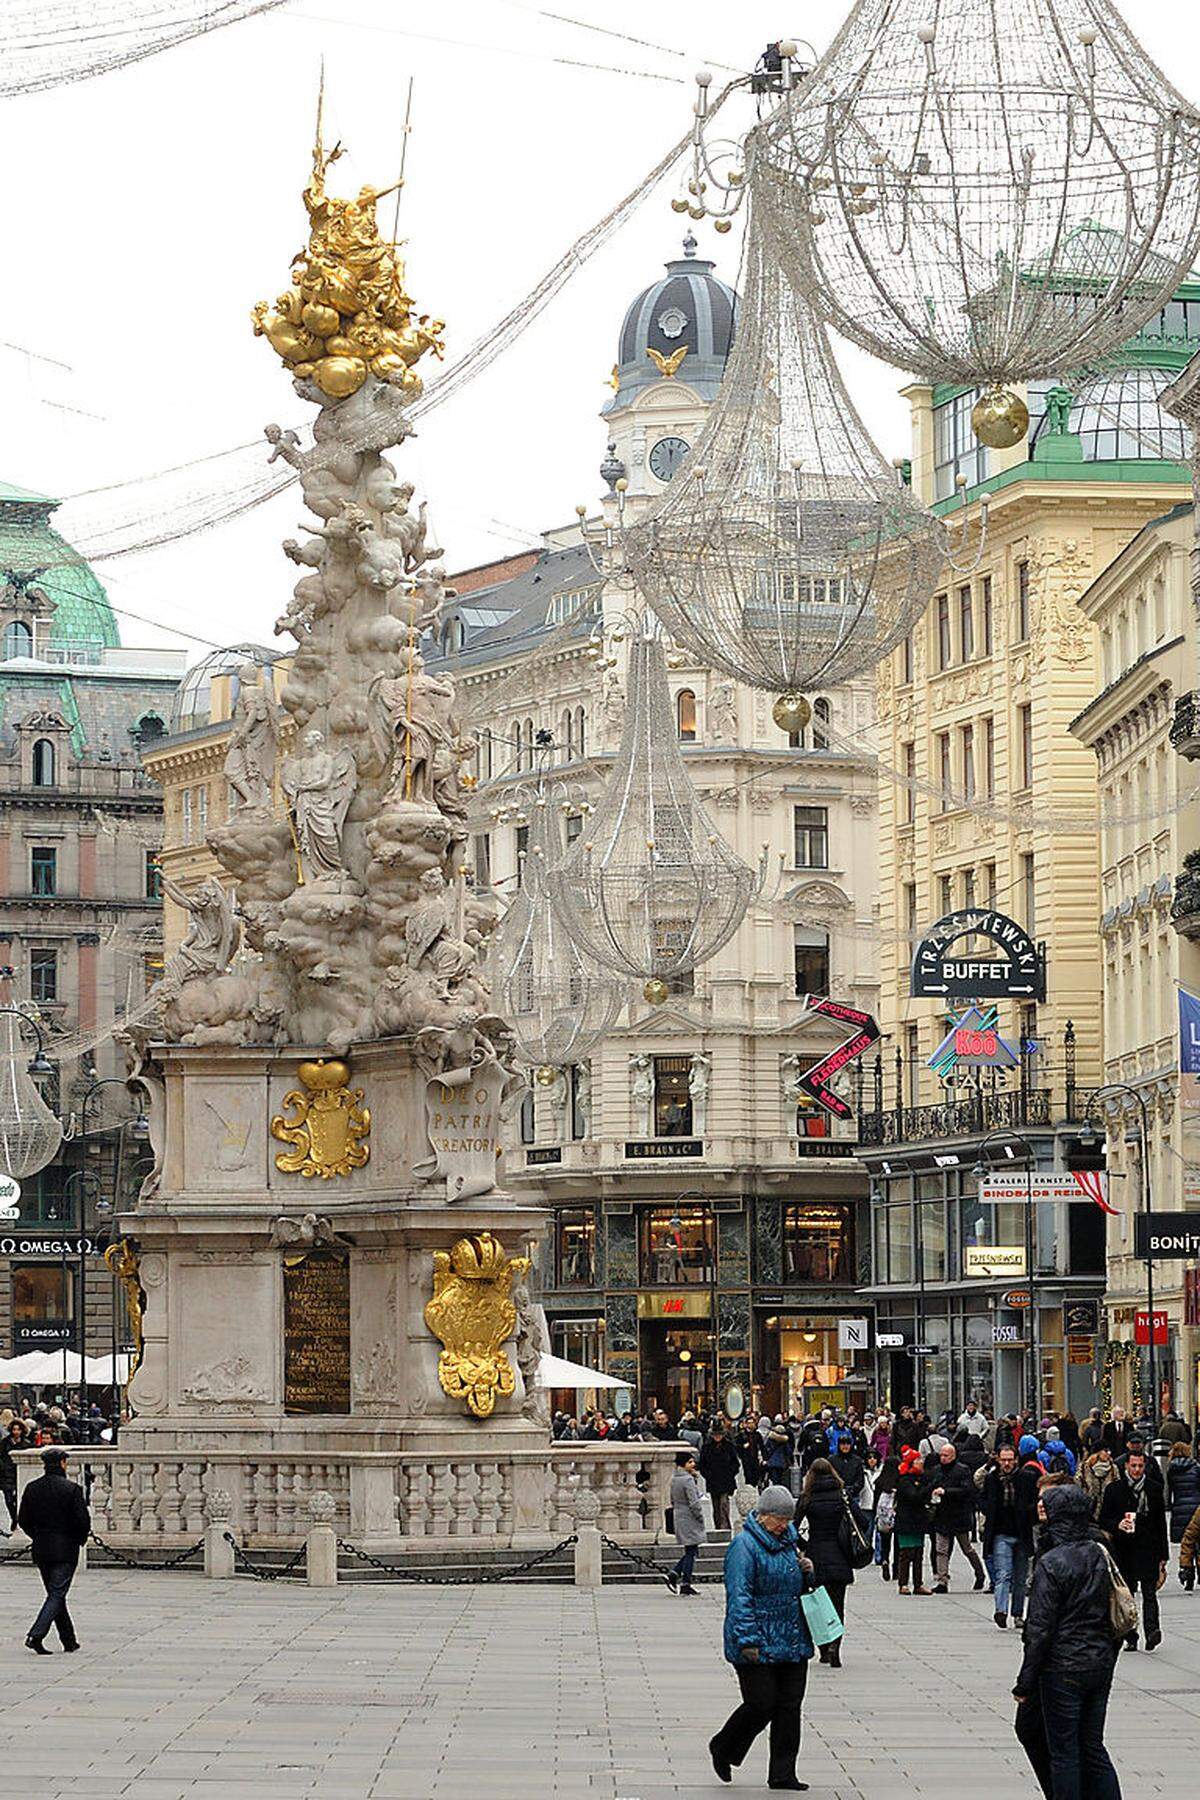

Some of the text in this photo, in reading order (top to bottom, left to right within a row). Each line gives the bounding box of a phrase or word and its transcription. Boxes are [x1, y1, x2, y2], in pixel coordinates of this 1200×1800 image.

[942, 963, 1012, 979] BUFFET
[810, 1034, 873, 1087] FLEDERMAUS
[441, 1086, 488, 1105] DEO
[434, 1113, 492, 1129] PATRI
[644, 1145, 674, 1156] BRAUN
[20, 1241, 72, 1253] OMEGA
[991, 1325, 1018, 1341] FOSSIL
